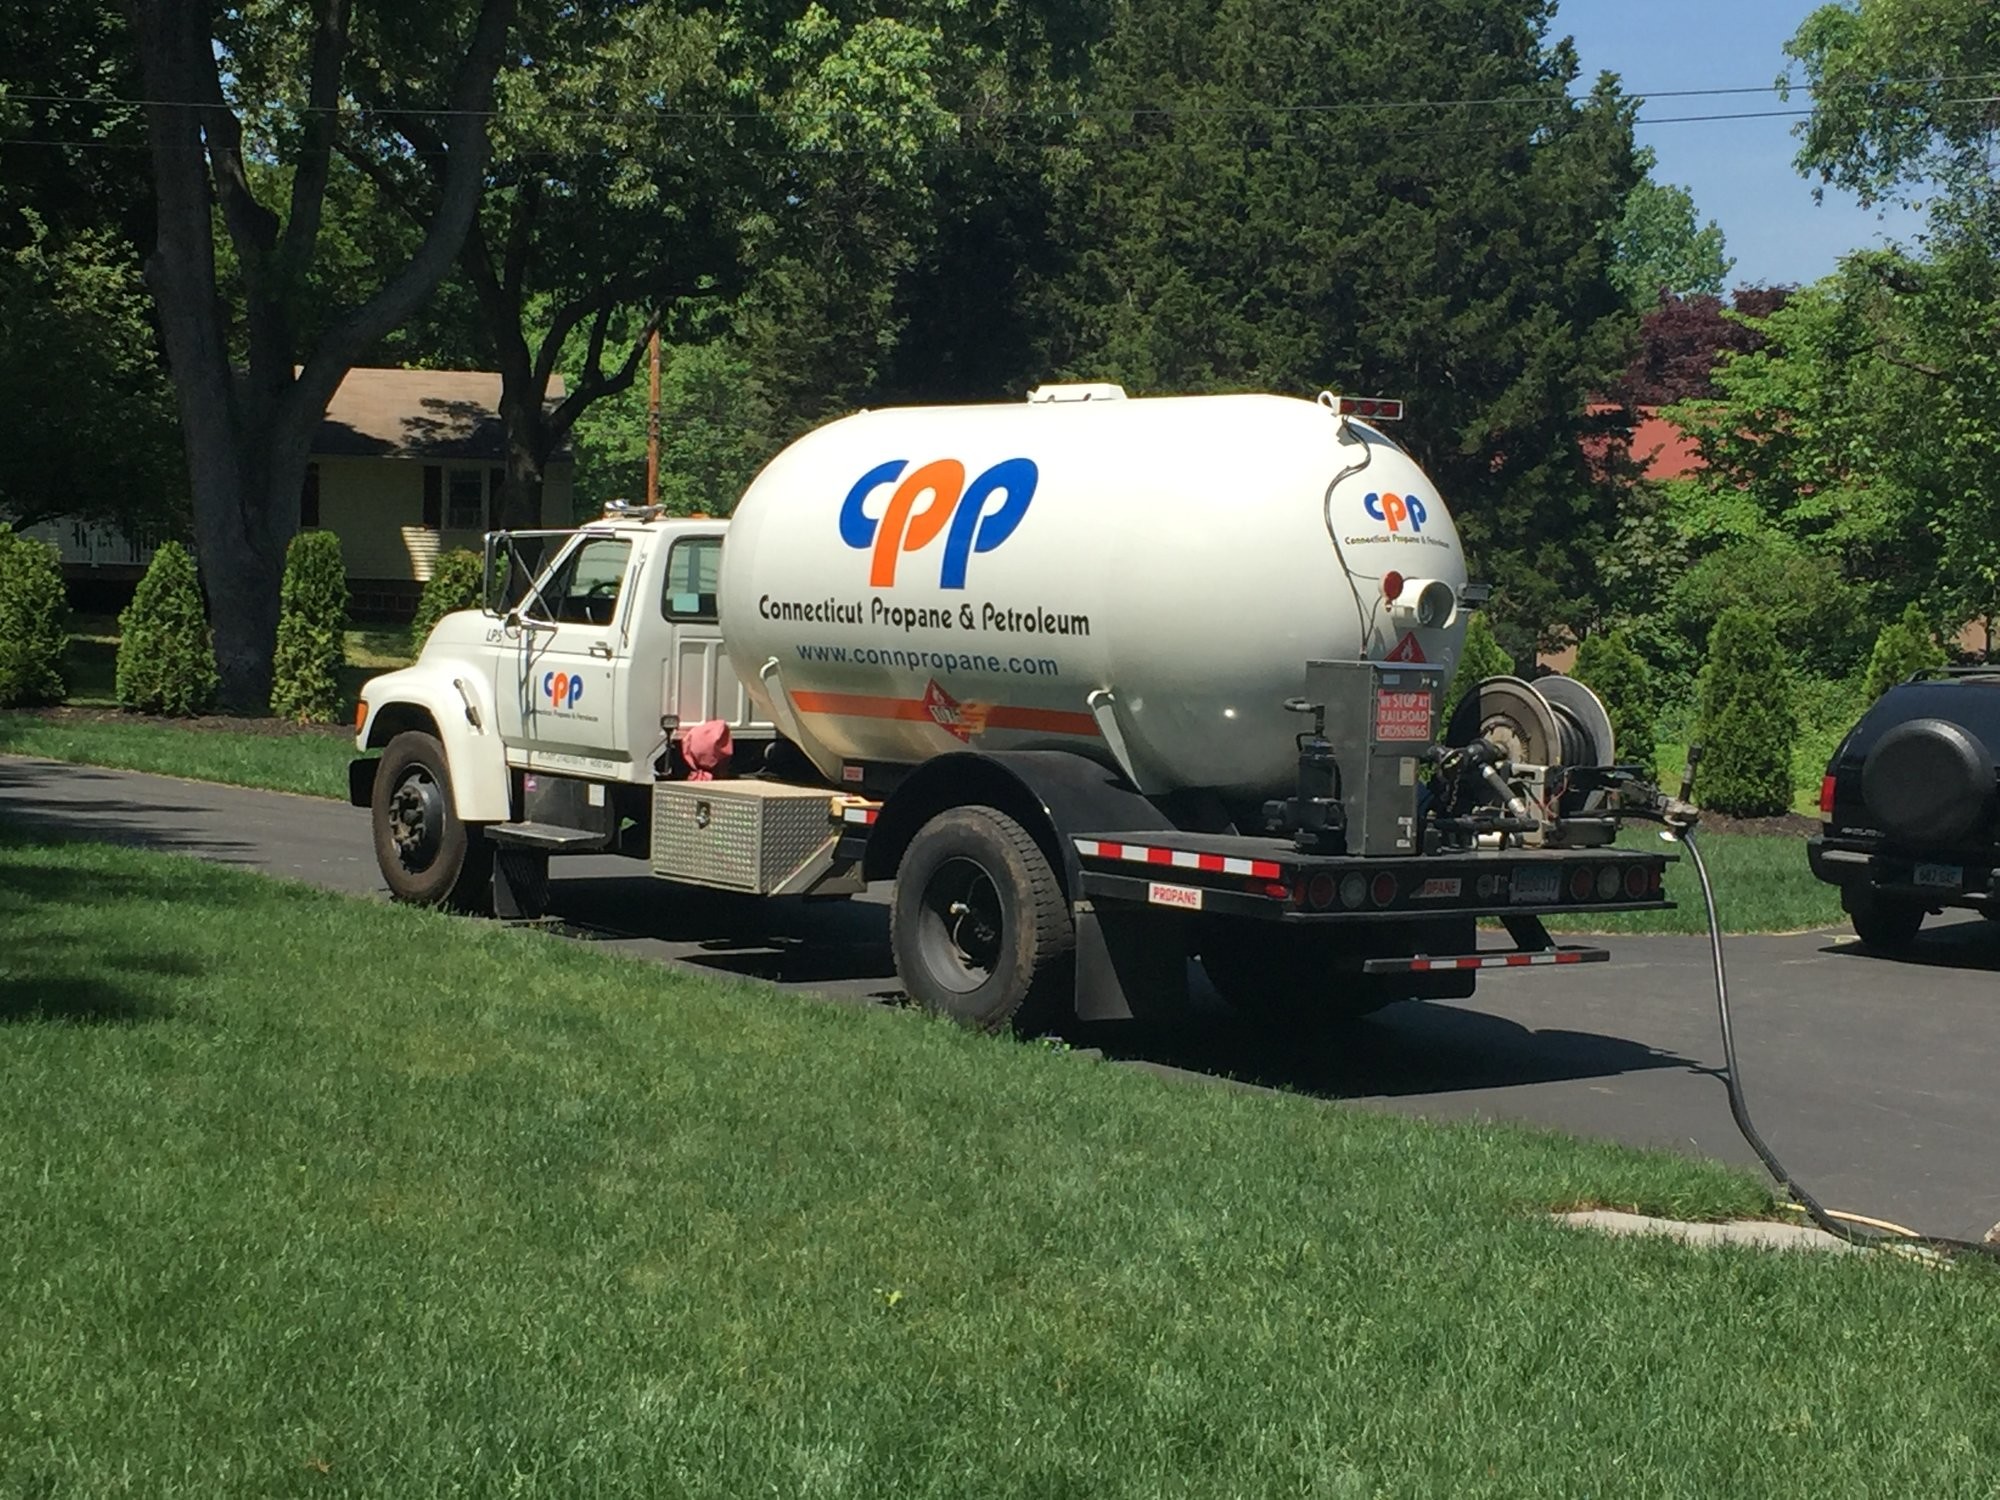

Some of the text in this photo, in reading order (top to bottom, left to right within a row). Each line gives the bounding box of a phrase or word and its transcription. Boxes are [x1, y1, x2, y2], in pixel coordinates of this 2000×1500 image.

[758, 594, 1091, 637] Connecticut Propane & Petroleum
[796, 644, 1059, 676] www.connpropane.com
[1392, 693, 1417, 708] STOP
[1418, 695, 1429, 708] AT
[1380, 710, 1428, 722] RAILROAD
[1378, 724, 1427, 737] CROSSINGS
[1153, 886, 1197, 905] PROPANE
